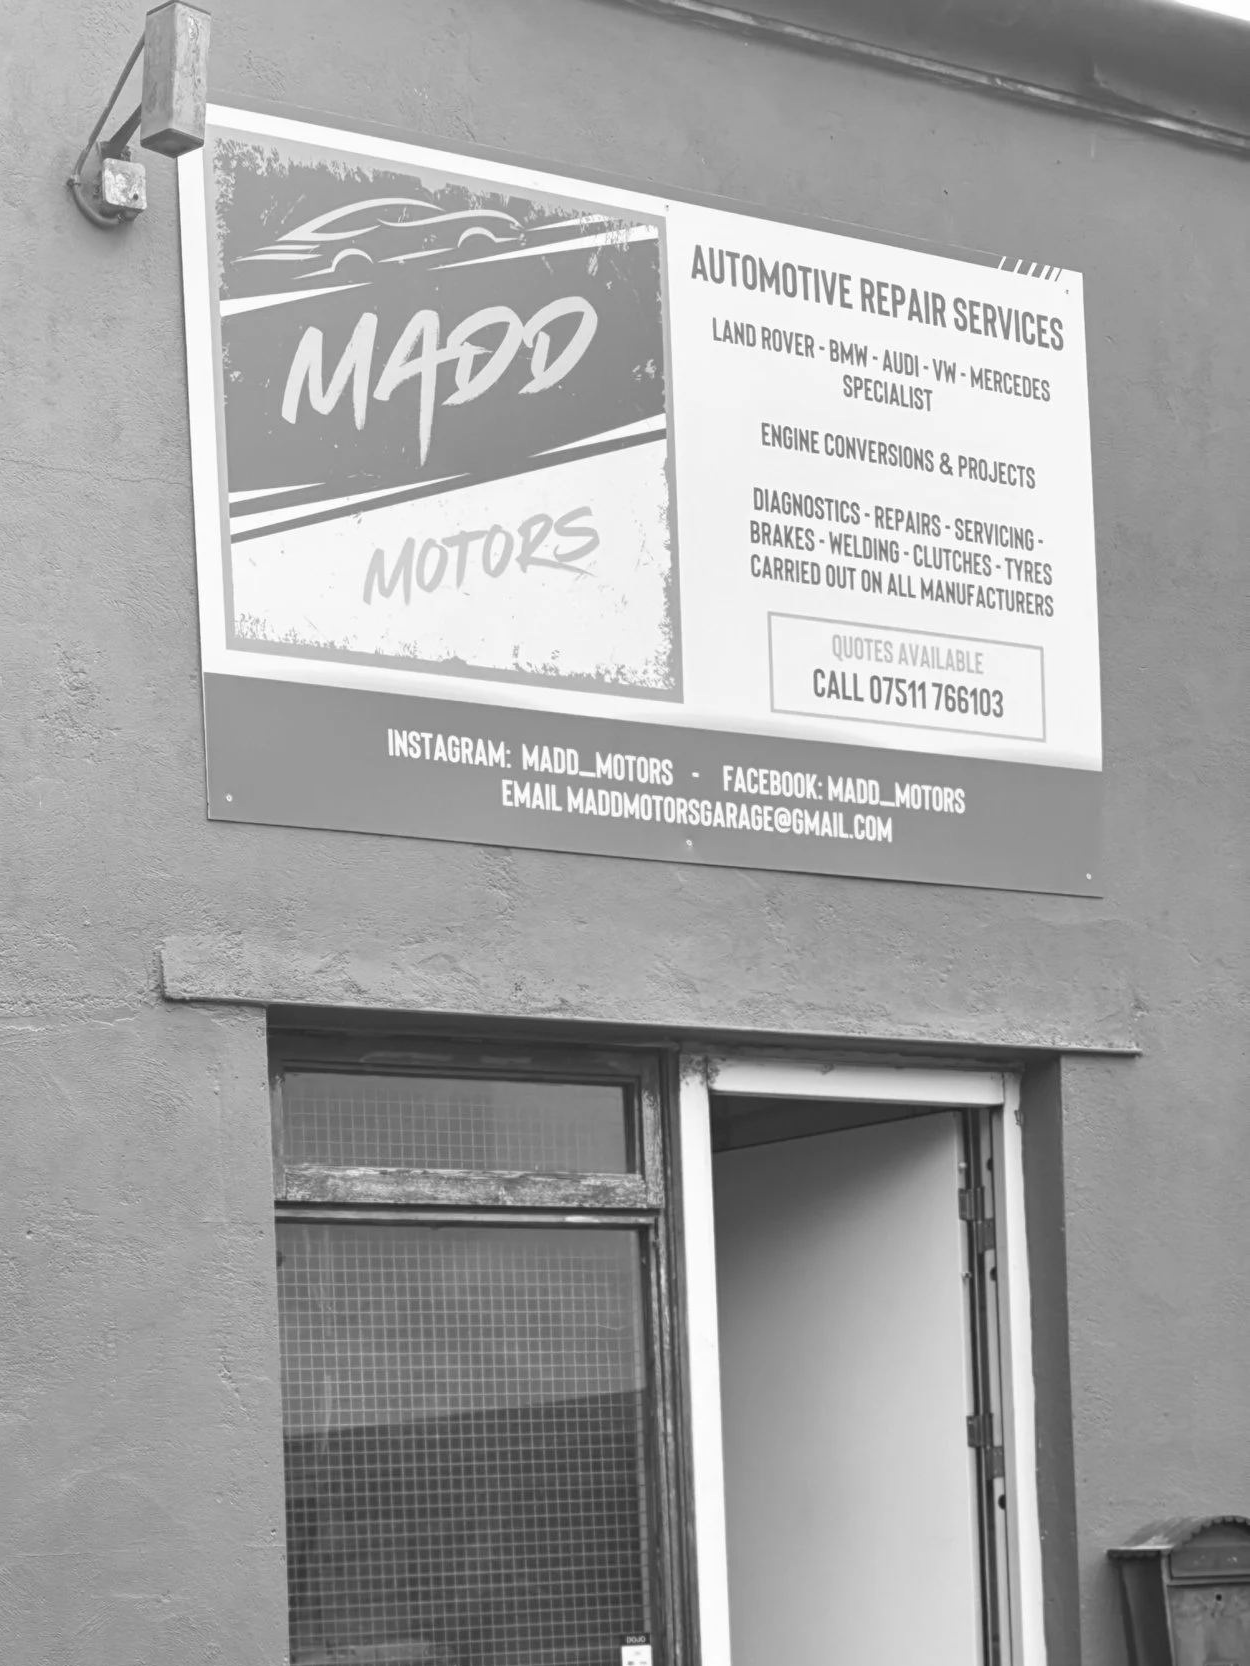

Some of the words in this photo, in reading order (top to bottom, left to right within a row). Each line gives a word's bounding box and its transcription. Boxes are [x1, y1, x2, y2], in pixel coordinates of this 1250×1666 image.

[691, 244, 854, 310] AUTOMOTIVE
[859, 277, 947, 328] REPAIR
[952, 297, 1064, 351] SERVICES
[282, 295, 599, 468] MADD
[712, 317, 757, 347] LAND
[761, 326, 815, 359] ROVER
[829, 338, 868, 368] BMW
[882, 349, 920, 378] AUDI
[932, 358, 957, 384] VW
[970, 365, 1051, 402] MERCEDES
[842, 374, 933, 412] SPECIALIST
[761, 422, 820, 455] ENGINE
[824, 432, 935, 473] CONVERSIONS
[939, 452, 954, 476] &
[957, 454, 1036, 490] PROJECTS
[749, 519, 816, 552] BRAKES
[828, 531, 901, 564] WELDING
[913, 543, 992, 577] CLUTCHES
[1004, 557, 1053, 586] TYRES
[753, 486, 861, 526] DIAGNOSTICS
[874, 505, 942, 538] REPAIRS
[954, 517, 1035, 552] SERVICING
[362, 506, 601, 606] MOTORS
[750, 553, 821, 586] CARRIED
[825, 563, 857, 592] OUT
[860, 569, 883, 594] ON
[887, 572, 917, 600] ALL
[920, 577, 1054, 618] MANUFACTURERS
[832, 634, 894, 664] QUOTES
[898, 642, 985, 676] AVAILABLE
[812, 667, 865, 703] CALL
[869, 674, 927, 710] 07511
[931, 681, 1004, 719] 766103
[387, 728, 512, 769] INSTAGRAM:
[522, 743, 674, 786] MADD_MOTORS
[722, 765, 823, 800] FACEBOOK:
[827, 775, 966, 814] MADD_MOTORS
[501, 779, 563, 812] EMAIL
[566, 785, 893, 843] MADDMOTORSGARAGE@GMAIL.COM
